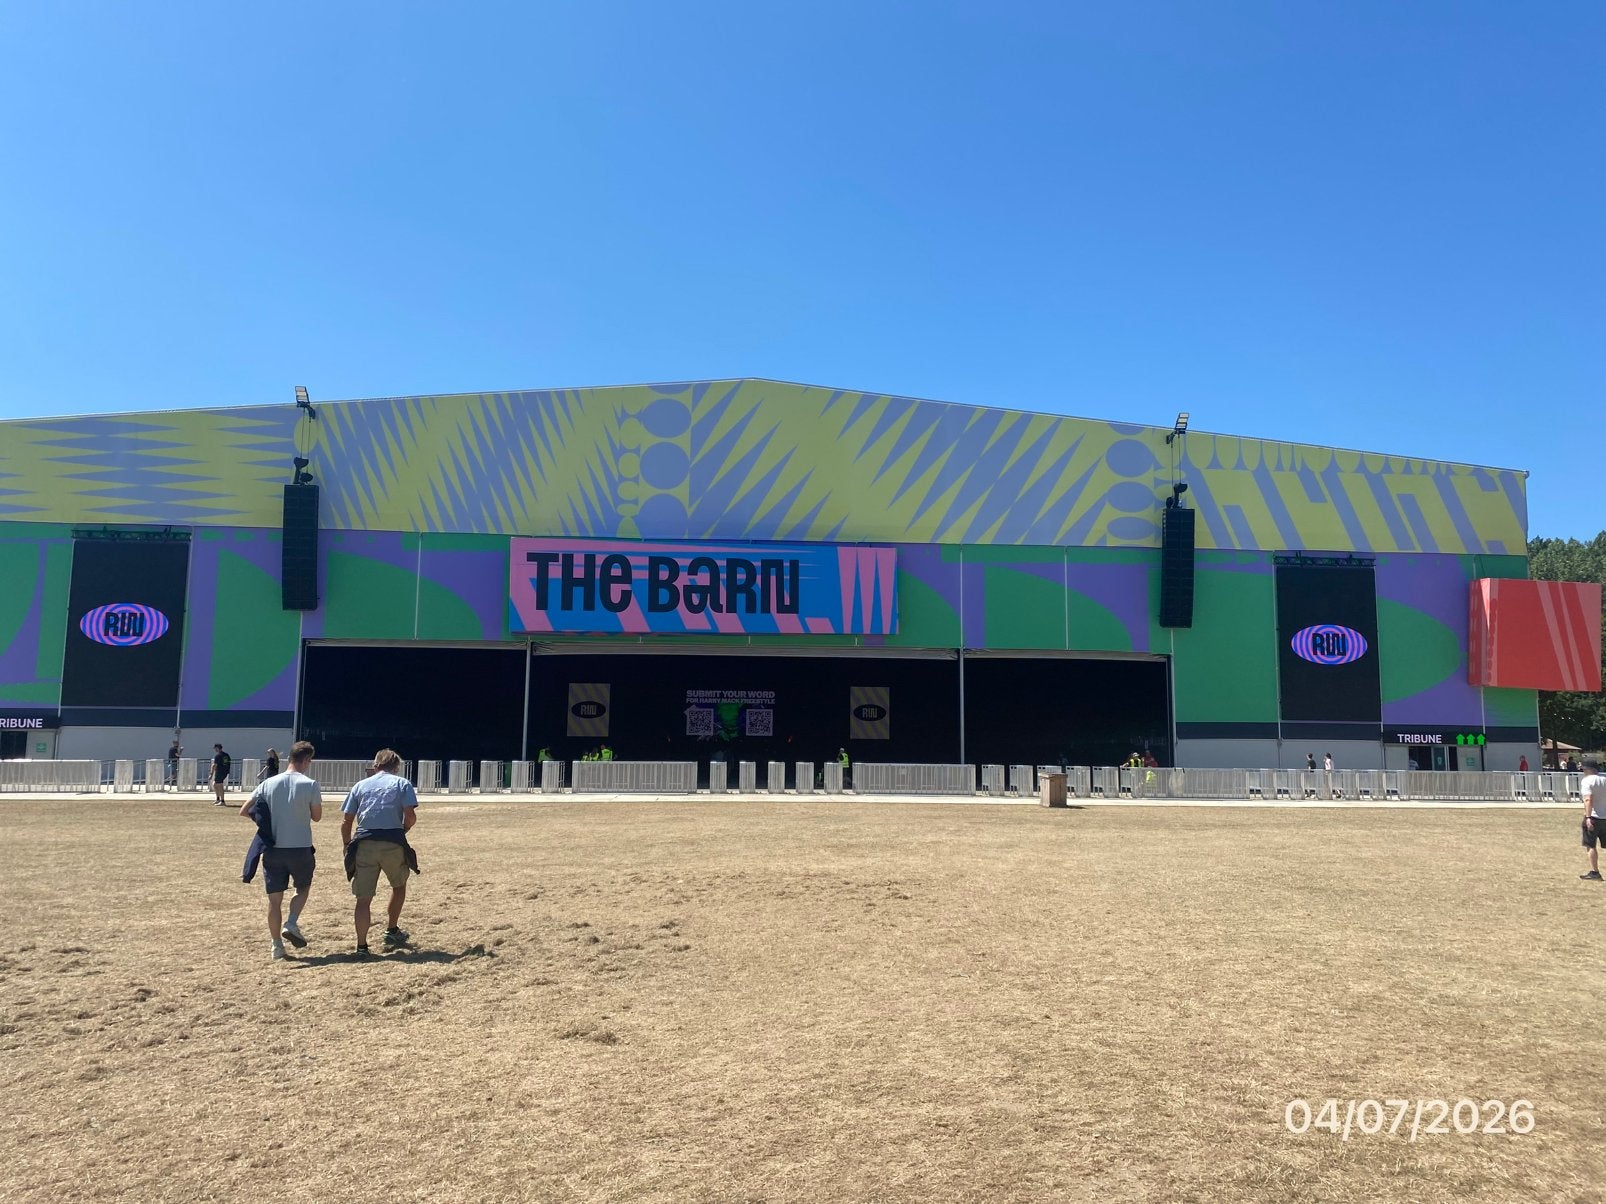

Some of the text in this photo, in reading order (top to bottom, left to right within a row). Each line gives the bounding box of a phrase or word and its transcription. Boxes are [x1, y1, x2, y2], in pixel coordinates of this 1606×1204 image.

[686, 690, 721, 698] SUBMIT
[722, 690, 747, 698] YOUR
[0, 718, 43, 728] RIBUNE
[1397, 734, 1442, 743] TRIBUNE
